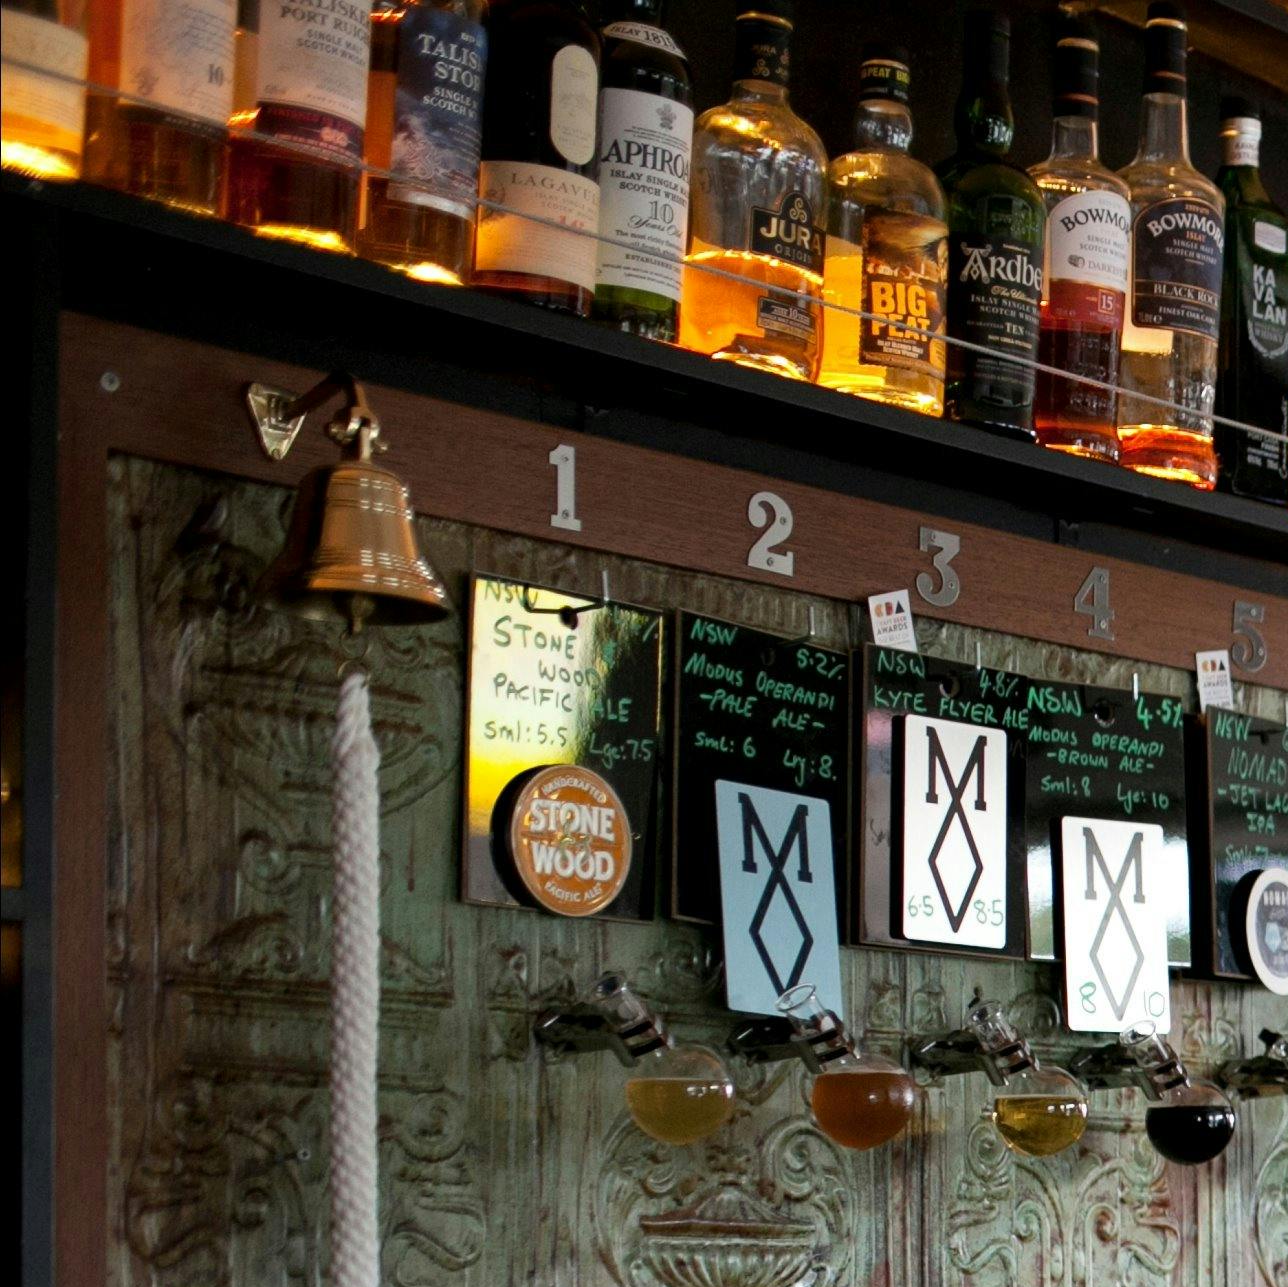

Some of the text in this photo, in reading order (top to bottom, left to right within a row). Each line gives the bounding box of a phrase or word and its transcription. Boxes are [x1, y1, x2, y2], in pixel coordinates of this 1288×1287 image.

[610, 169, 643, 181] ISLAY
[646, 175, 678, 192] SINGLE
[619, 181, 661, 197] SCOTCH
[648, 201, 674, 224] 10
[760, 217, 822, 256] JURA
[1153, 283, 1194, 300] BLACK
[1253, 264, 1276, 287] KA
[872, 281, 926, 317] BIG
[1101, 294, 1115, 310] 15
[1254, 282, 1276, 305] VA
[871, 313, 930, 342] PEAT
[1252, 303, 1287, 325] LAN
[548, 444, 582, 531] 1
[746, 491, 793, 576] 2
[916, 526, 961, 607] 3
[1073, 566, 1115, 641] 4
[493, 615, 577, 660] STONE
[691, 618, 738, 646] NSW
[1231, 600, 1267, 673] 5
[877, 651, 926, 678] NSW
[493, 673, 573, 713] PACIFIC
[755, 670, 835, 710] OPERANDI
[874, 685, 1029, 729] KYTE FLYER ALE
[1215, 712, 1251, 741] NSW
[1092, 732, 1164, 758] OPERANDI
[1227, 747, 1287, 786] NOMAD
[1151, 792, 1170, 809] 10
[530, 798, 615, 842] STONE
[531, 841, 615, 882] WOOD
[907, 895, 1004, 927] 6.5 8.5
[1079, 981, 1166, 1018] 8 10
